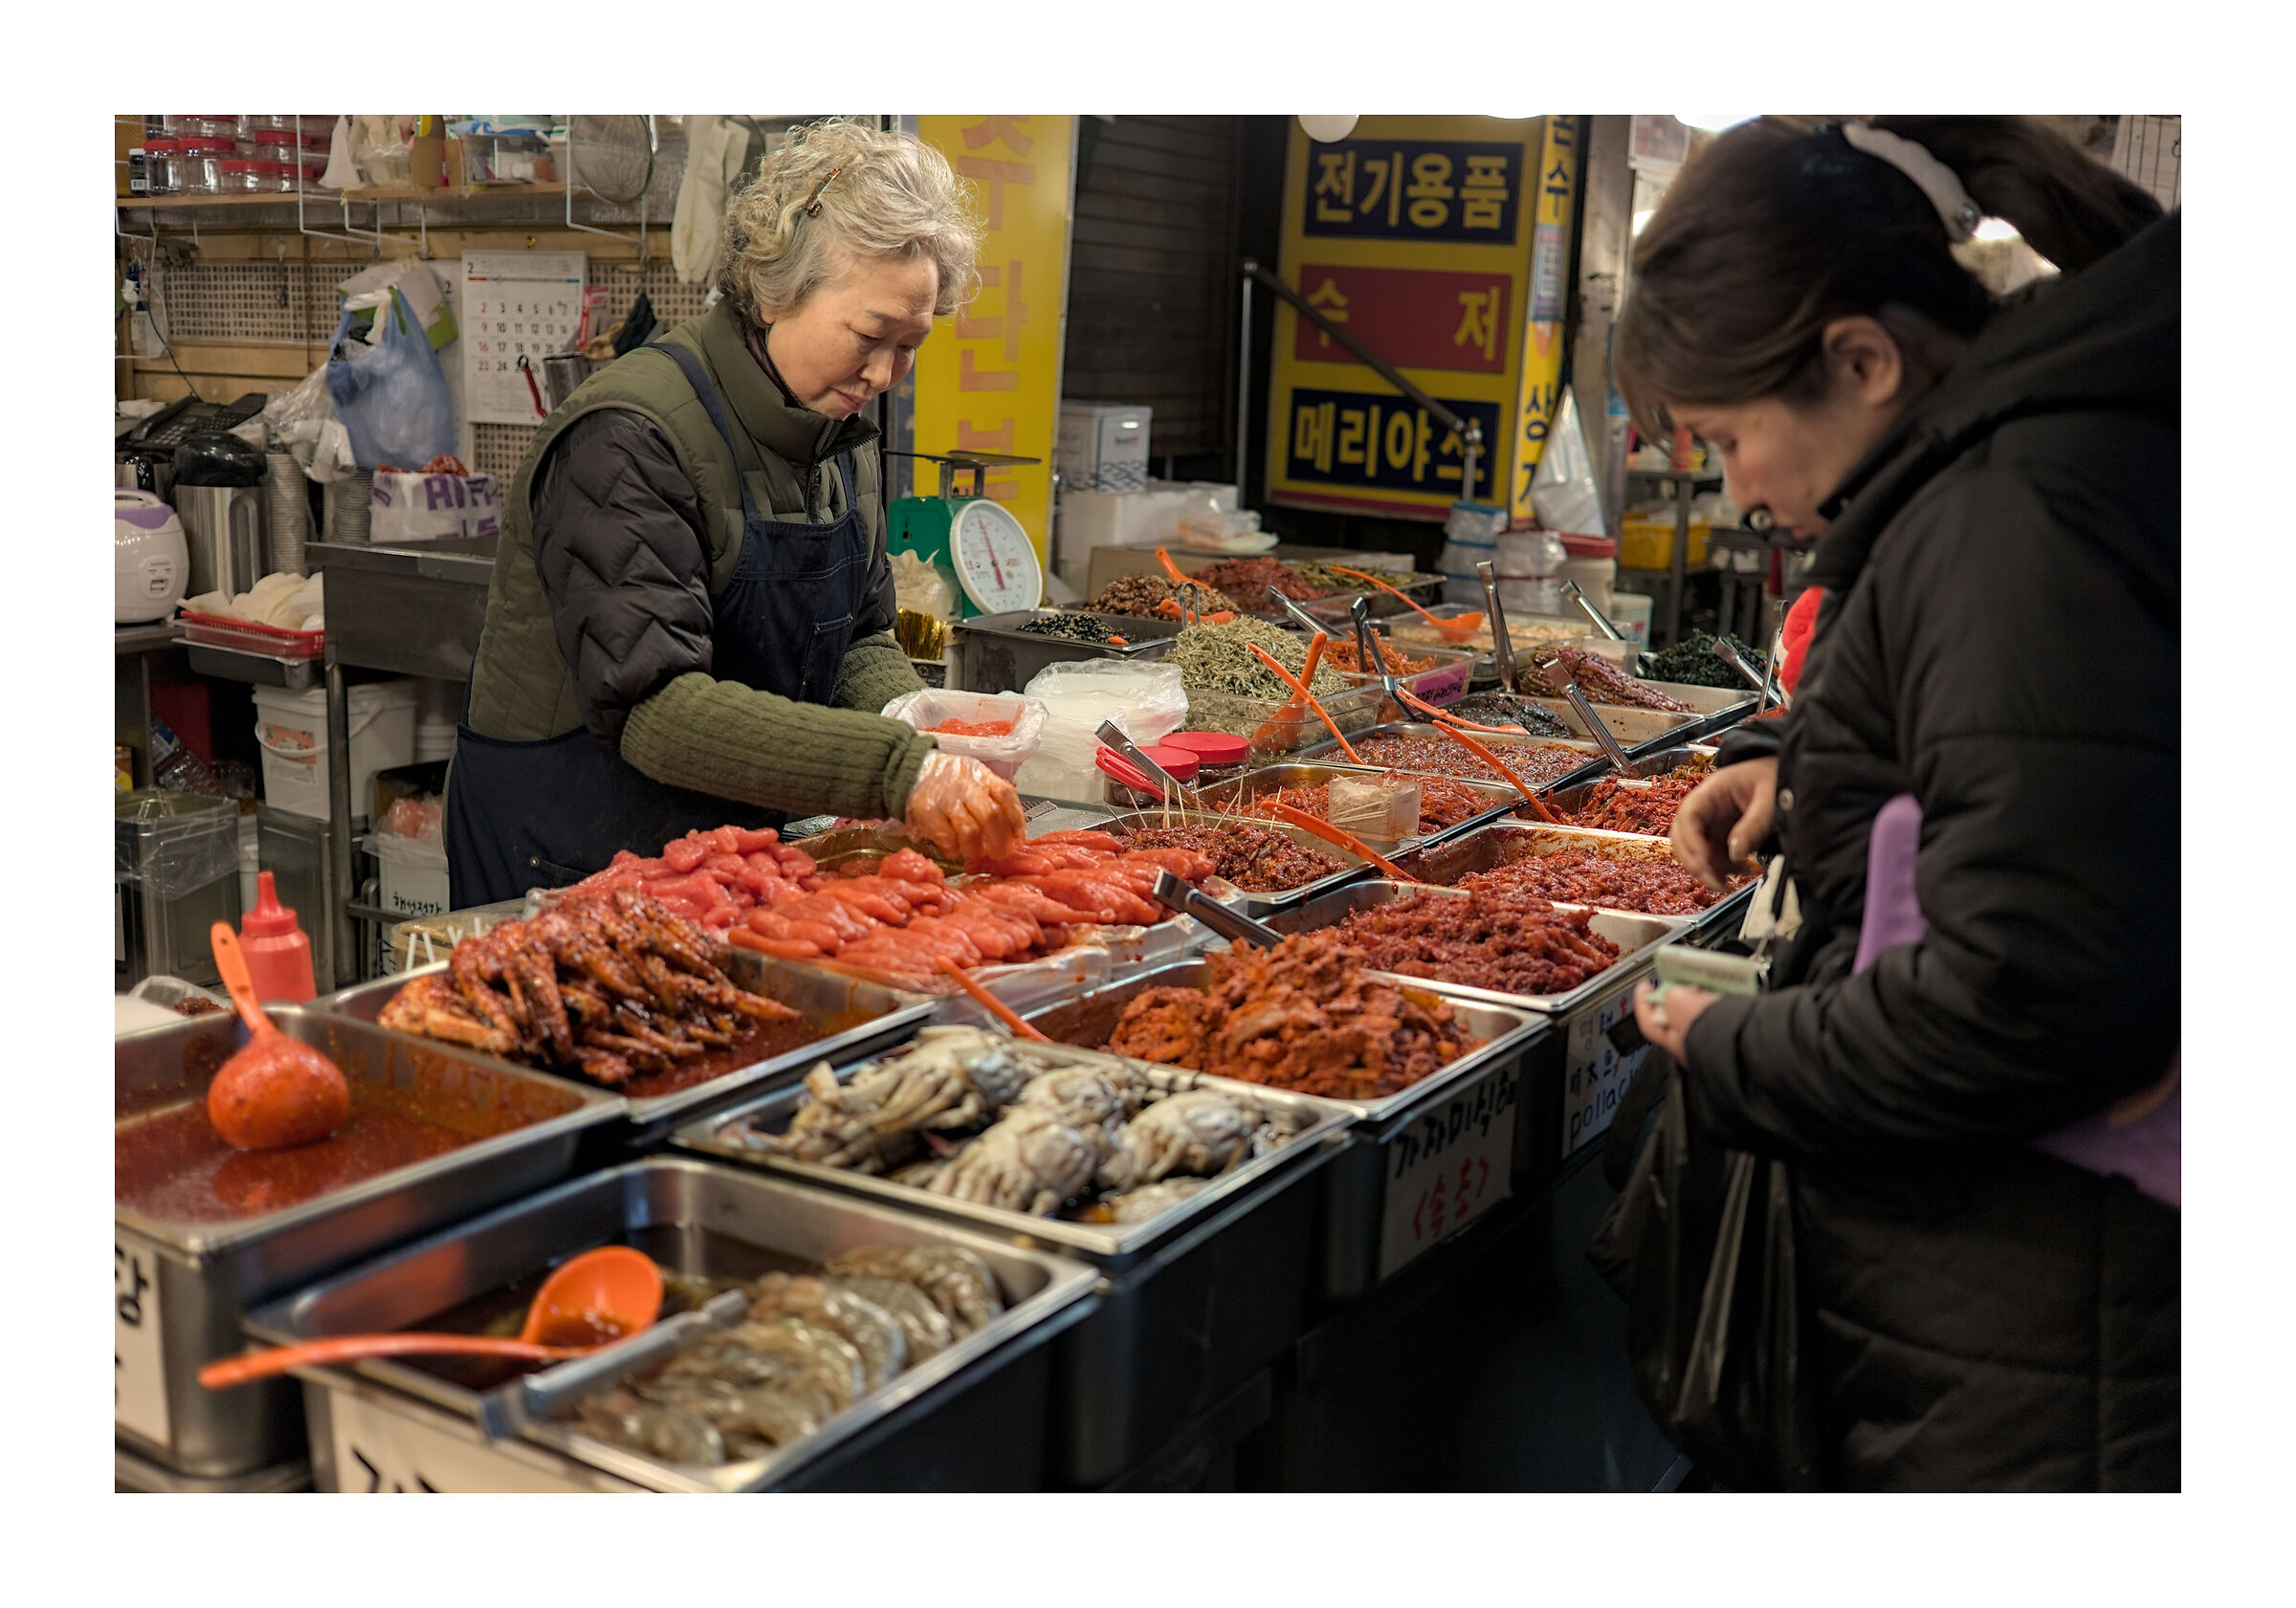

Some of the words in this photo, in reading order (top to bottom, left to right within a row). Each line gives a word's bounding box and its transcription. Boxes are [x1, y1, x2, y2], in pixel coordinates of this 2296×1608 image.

[1314, 151, 1511, 231] 전기용품
[467, 261, 475, 274] 2
[497, 321, 507, 333] 10
[515, 322, 522, 333] 11
[531, 322, 540, 334] 12
[478, 341, 489, 353] 16
[497, 341, 507, 353] 17
[478, 360, 489, 372] 23
[497, 360, 507, 372] 24
[1294, 402, 1487, 481] 메리야스
